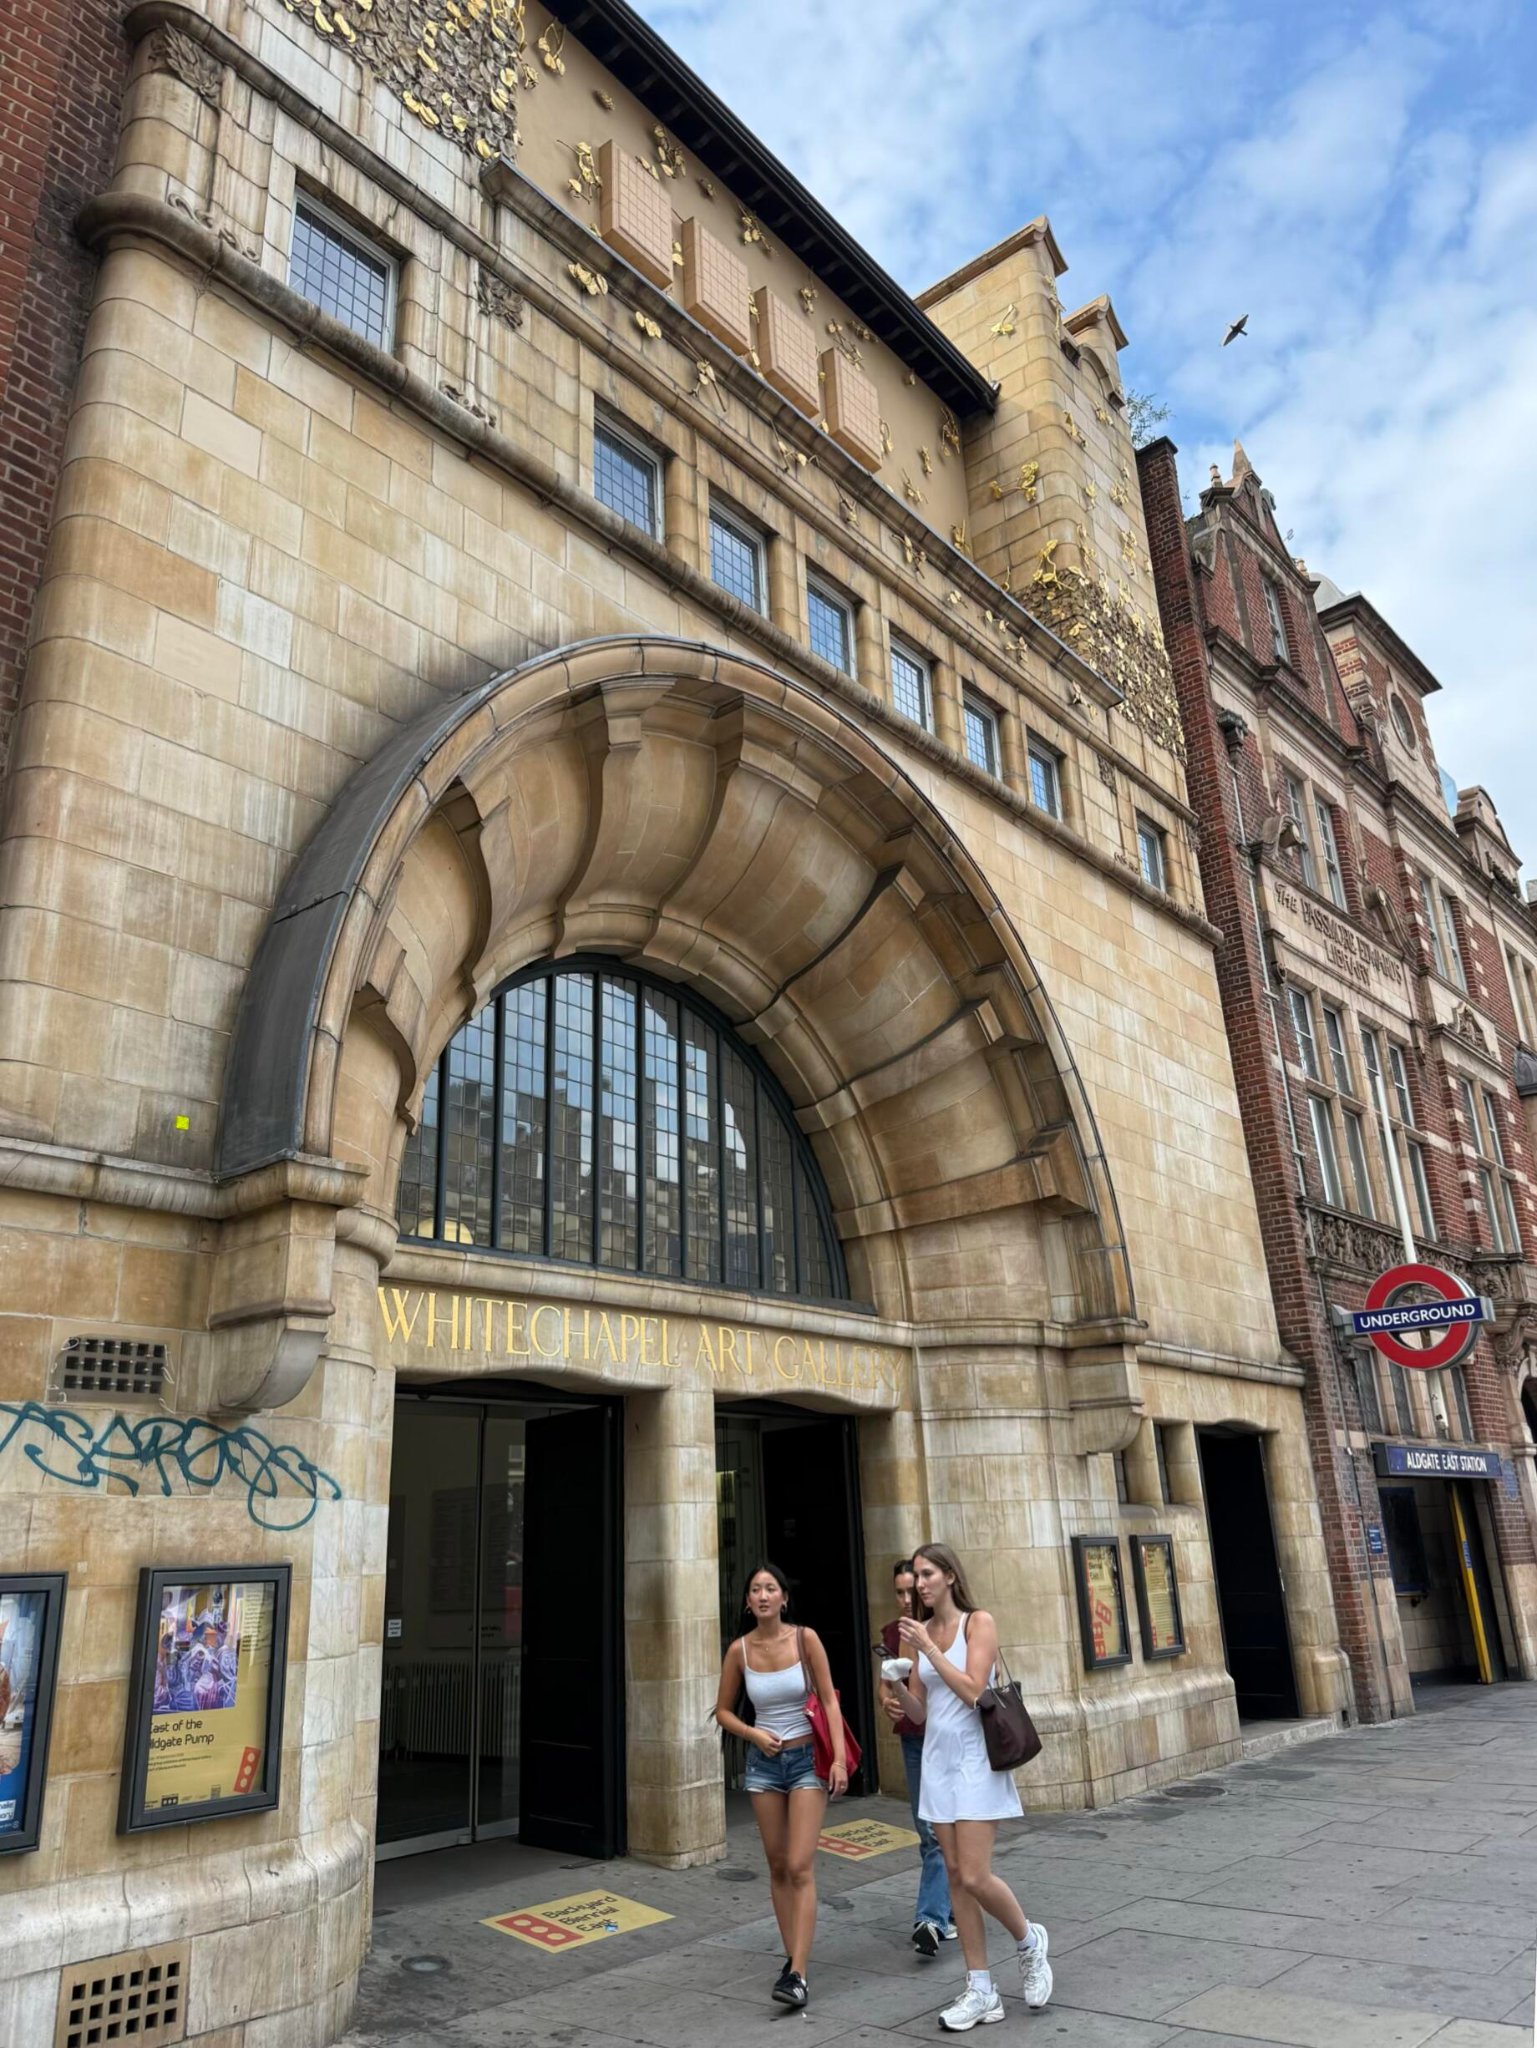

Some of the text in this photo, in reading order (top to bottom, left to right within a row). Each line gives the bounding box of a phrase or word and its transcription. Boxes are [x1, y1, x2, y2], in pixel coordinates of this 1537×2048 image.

[1274, 881, 1401, 985] THE PASSMORE EDWARDS
[1324, 939, 1371, 987] LIBRARY
[1360, 1303, 1475, 1328] UNDERGROUND
[377, 1286, 904, 1392] WHITECHAPEL ART GALLERY
[1407, 1452, 1487, 1472] ALDGATE EAST STATION
[150, 1718, 203, 1733] ast of the
[149, 1734, 214, 1751] ldgate Pump
[541, 1896, 617, 1918] Backyard
[558, 1906, 620, 1925] Biennial
